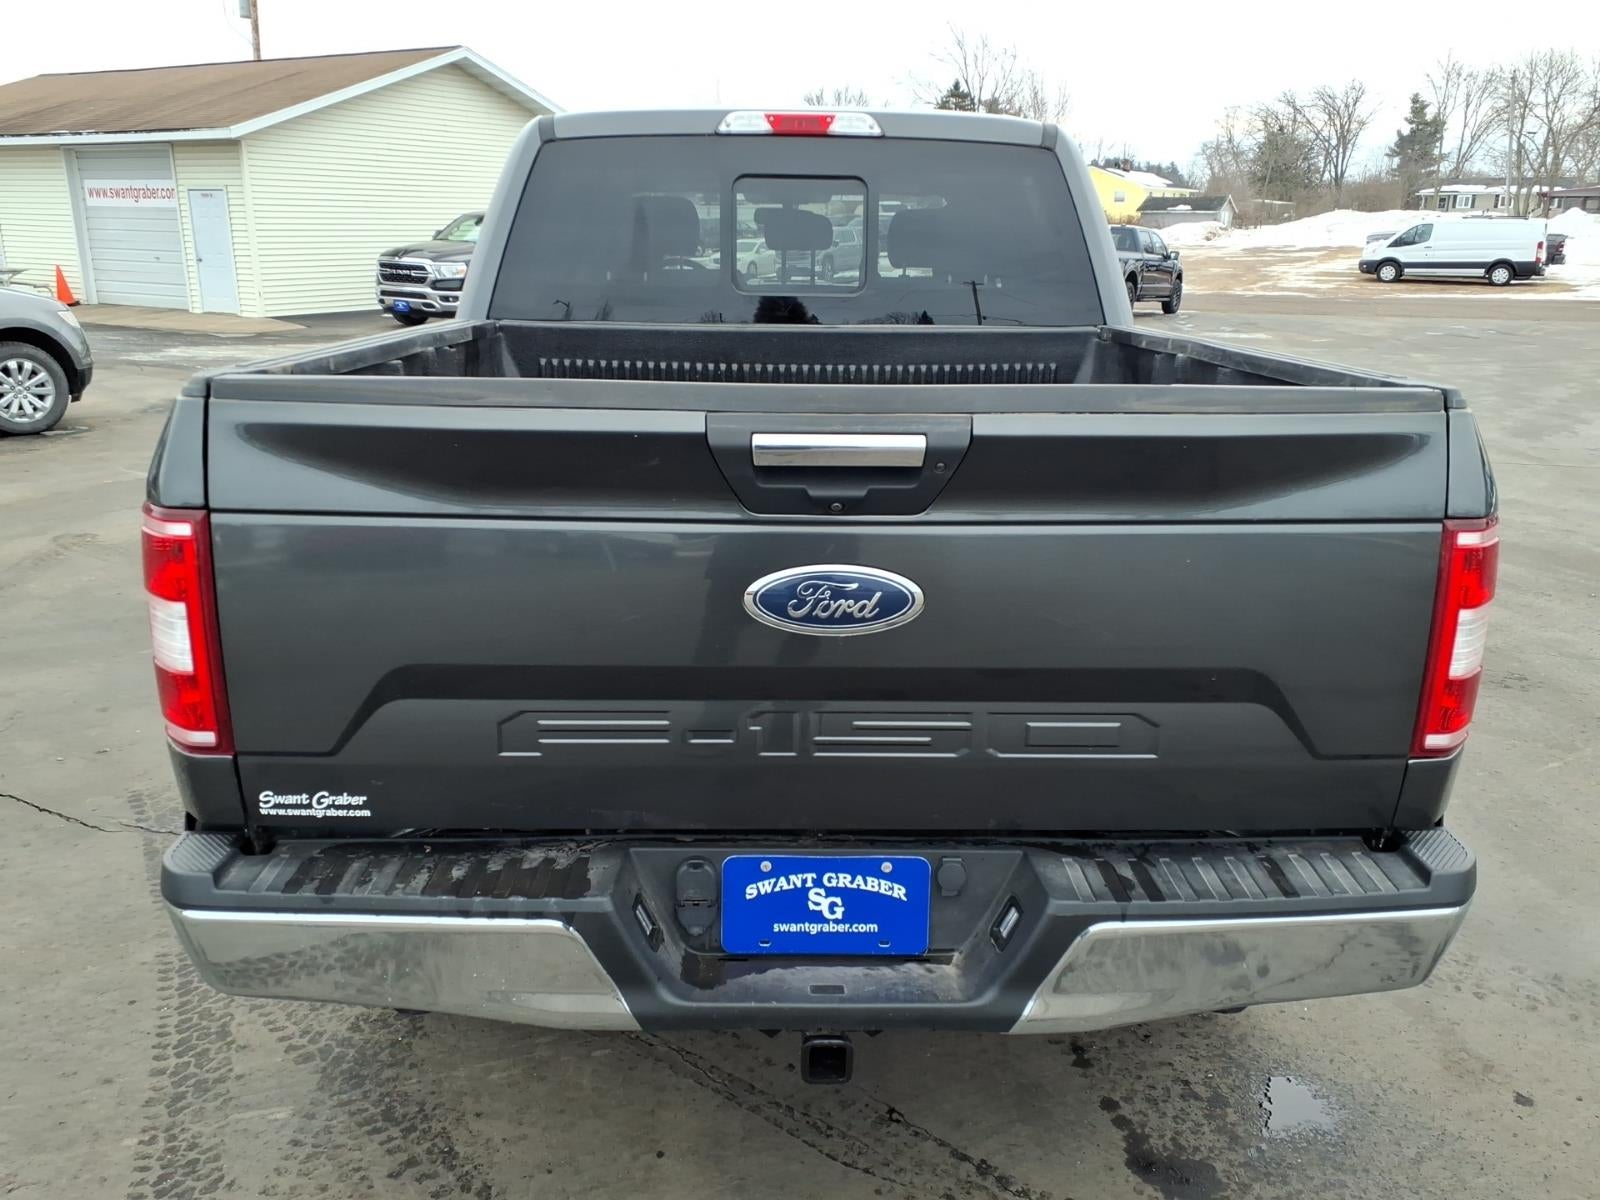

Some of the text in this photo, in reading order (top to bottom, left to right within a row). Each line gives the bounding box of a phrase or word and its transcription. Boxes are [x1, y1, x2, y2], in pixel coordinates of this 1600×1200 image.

[787, 580, 882, 619] Ford
[497, 710, 1160, 757] F-150
[259, 790, 367, 809] Swant Graber
[259, 807, 371, 818] www.swantgraber.com
[745, 872, 907, 901] SWANT GRABER
[808, 887, 845, 920] SG
[773, 921, 878, 935] swantgraber.com
